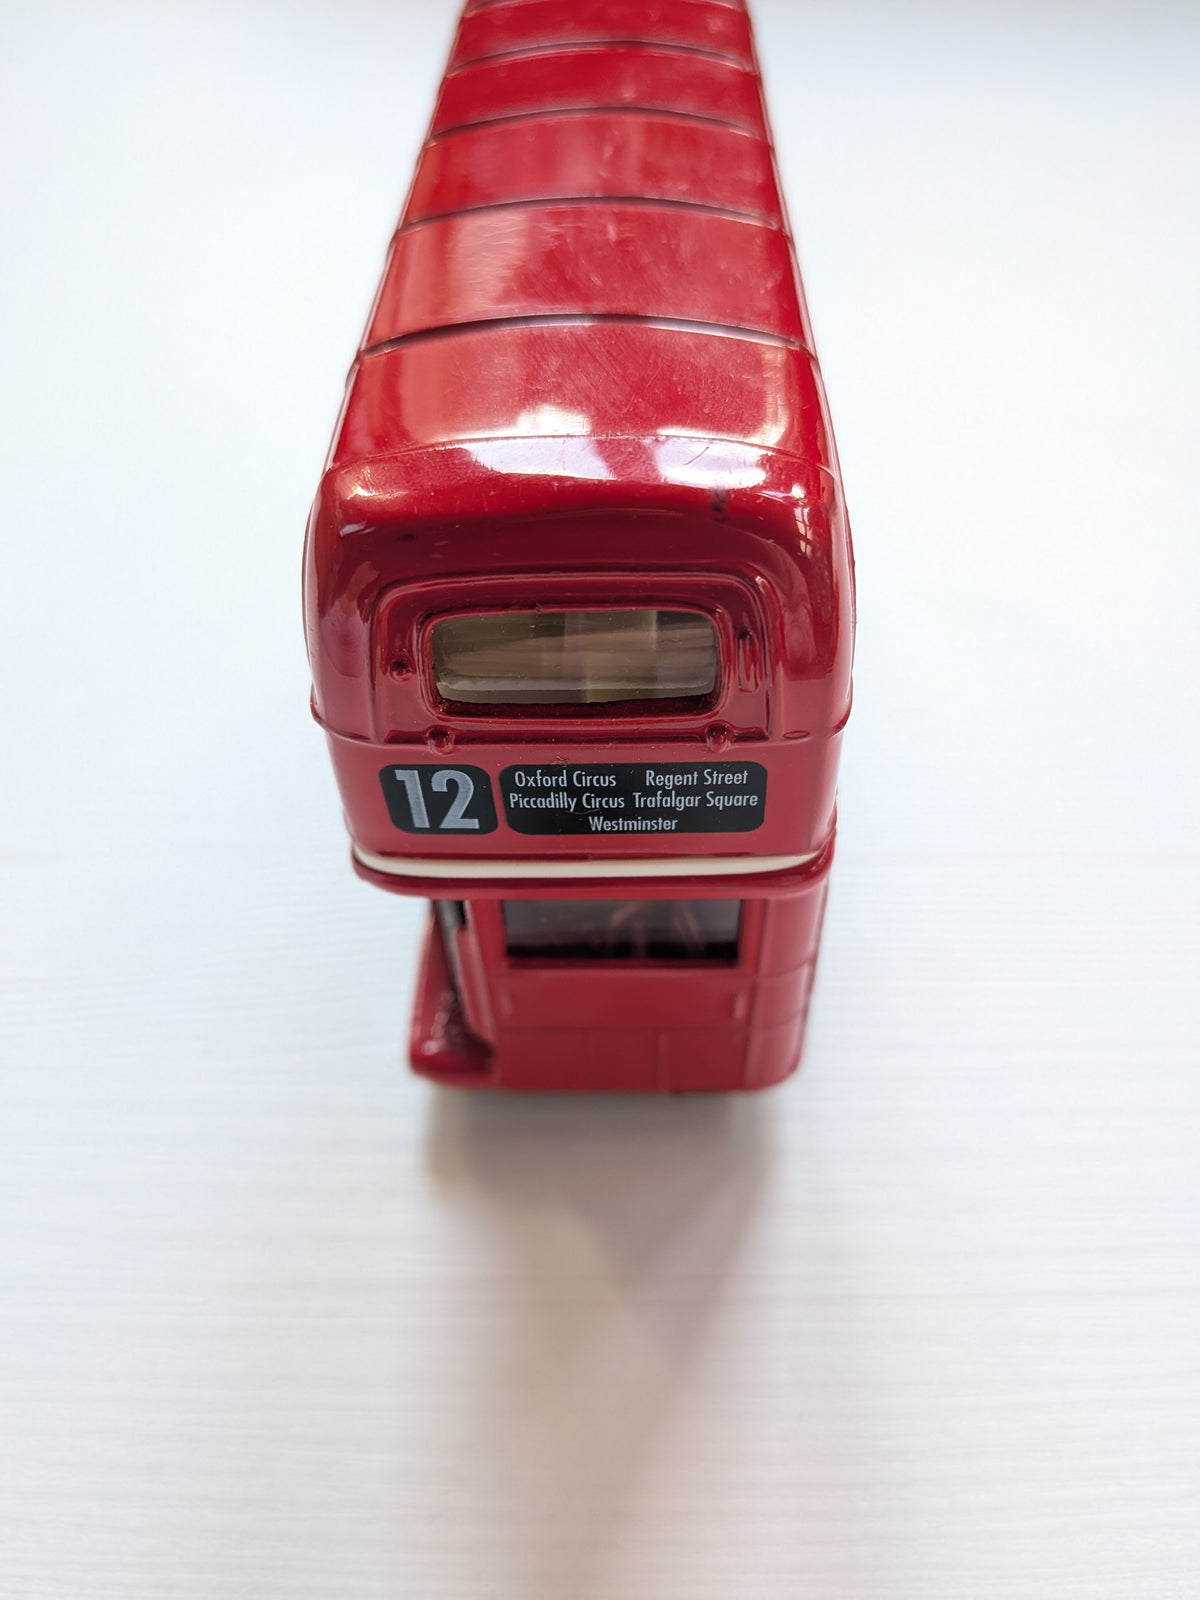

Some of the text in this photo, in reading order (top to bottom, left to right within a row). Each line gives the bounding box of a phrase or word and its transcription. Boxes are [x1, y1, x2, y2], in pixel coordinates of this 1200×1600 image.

[514, 768, 749, 790] Oxford Circus Regent Street
[394, 769, 480, 830] 12
[509, 790, 758, 813] Piccadilly Circus Trafalgar Square
[588, 815, 678, 832] Westminster
